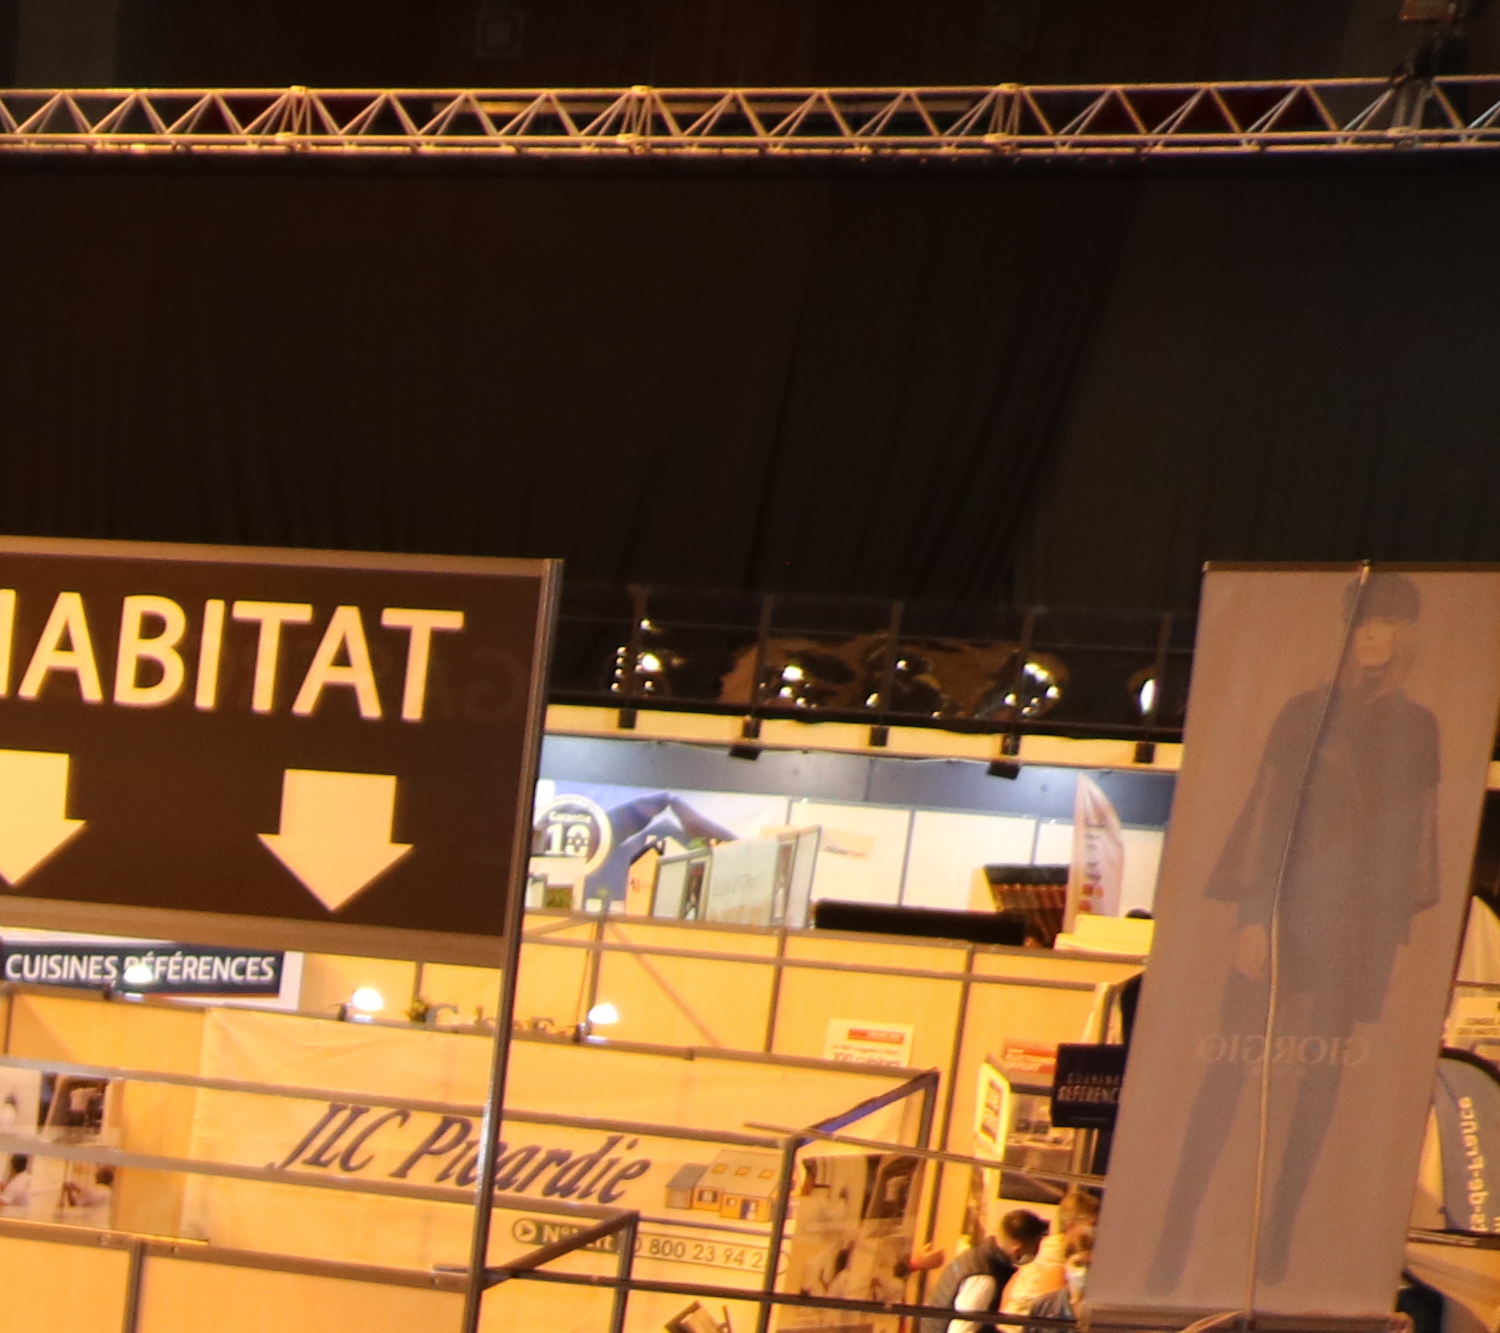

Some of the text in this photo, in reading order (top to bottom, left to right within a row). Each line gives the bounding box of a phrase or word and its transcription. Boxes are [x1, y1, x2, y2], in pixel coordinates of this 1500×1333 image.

[6, 953, 116, 982] CUISINES
[268, 1102, 653, 1205] JLC Piardie
[648, 1237, 749, 1268] 800 23 94
